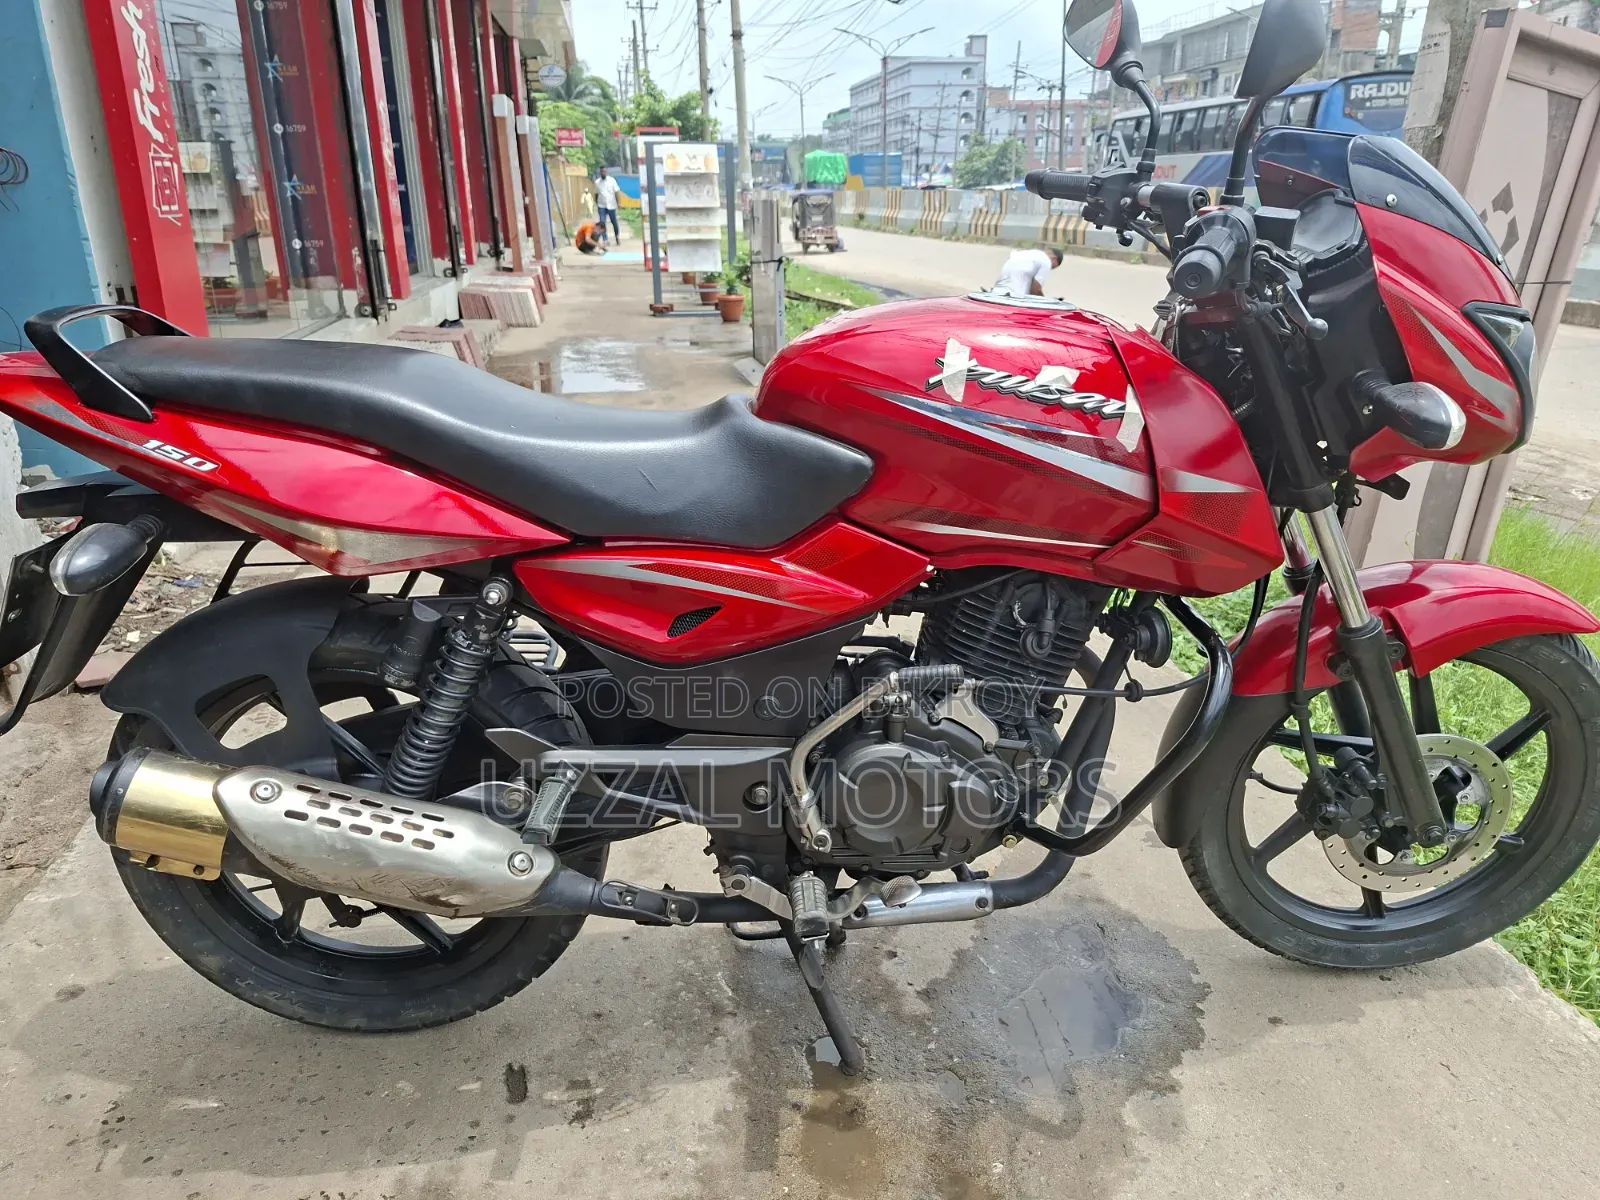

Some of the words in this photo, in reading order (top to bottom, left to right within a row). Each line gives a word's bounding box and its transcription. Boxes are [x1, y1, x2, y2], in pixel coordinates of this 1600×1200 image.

[266, 1, 288, 10] 16759
[120, 0, 164, 143] Fresh
[1350, 81, 1411, 99] RAJDU
[285, 124, 307, 133] 16759
[142, 439, 219, 472] 150
